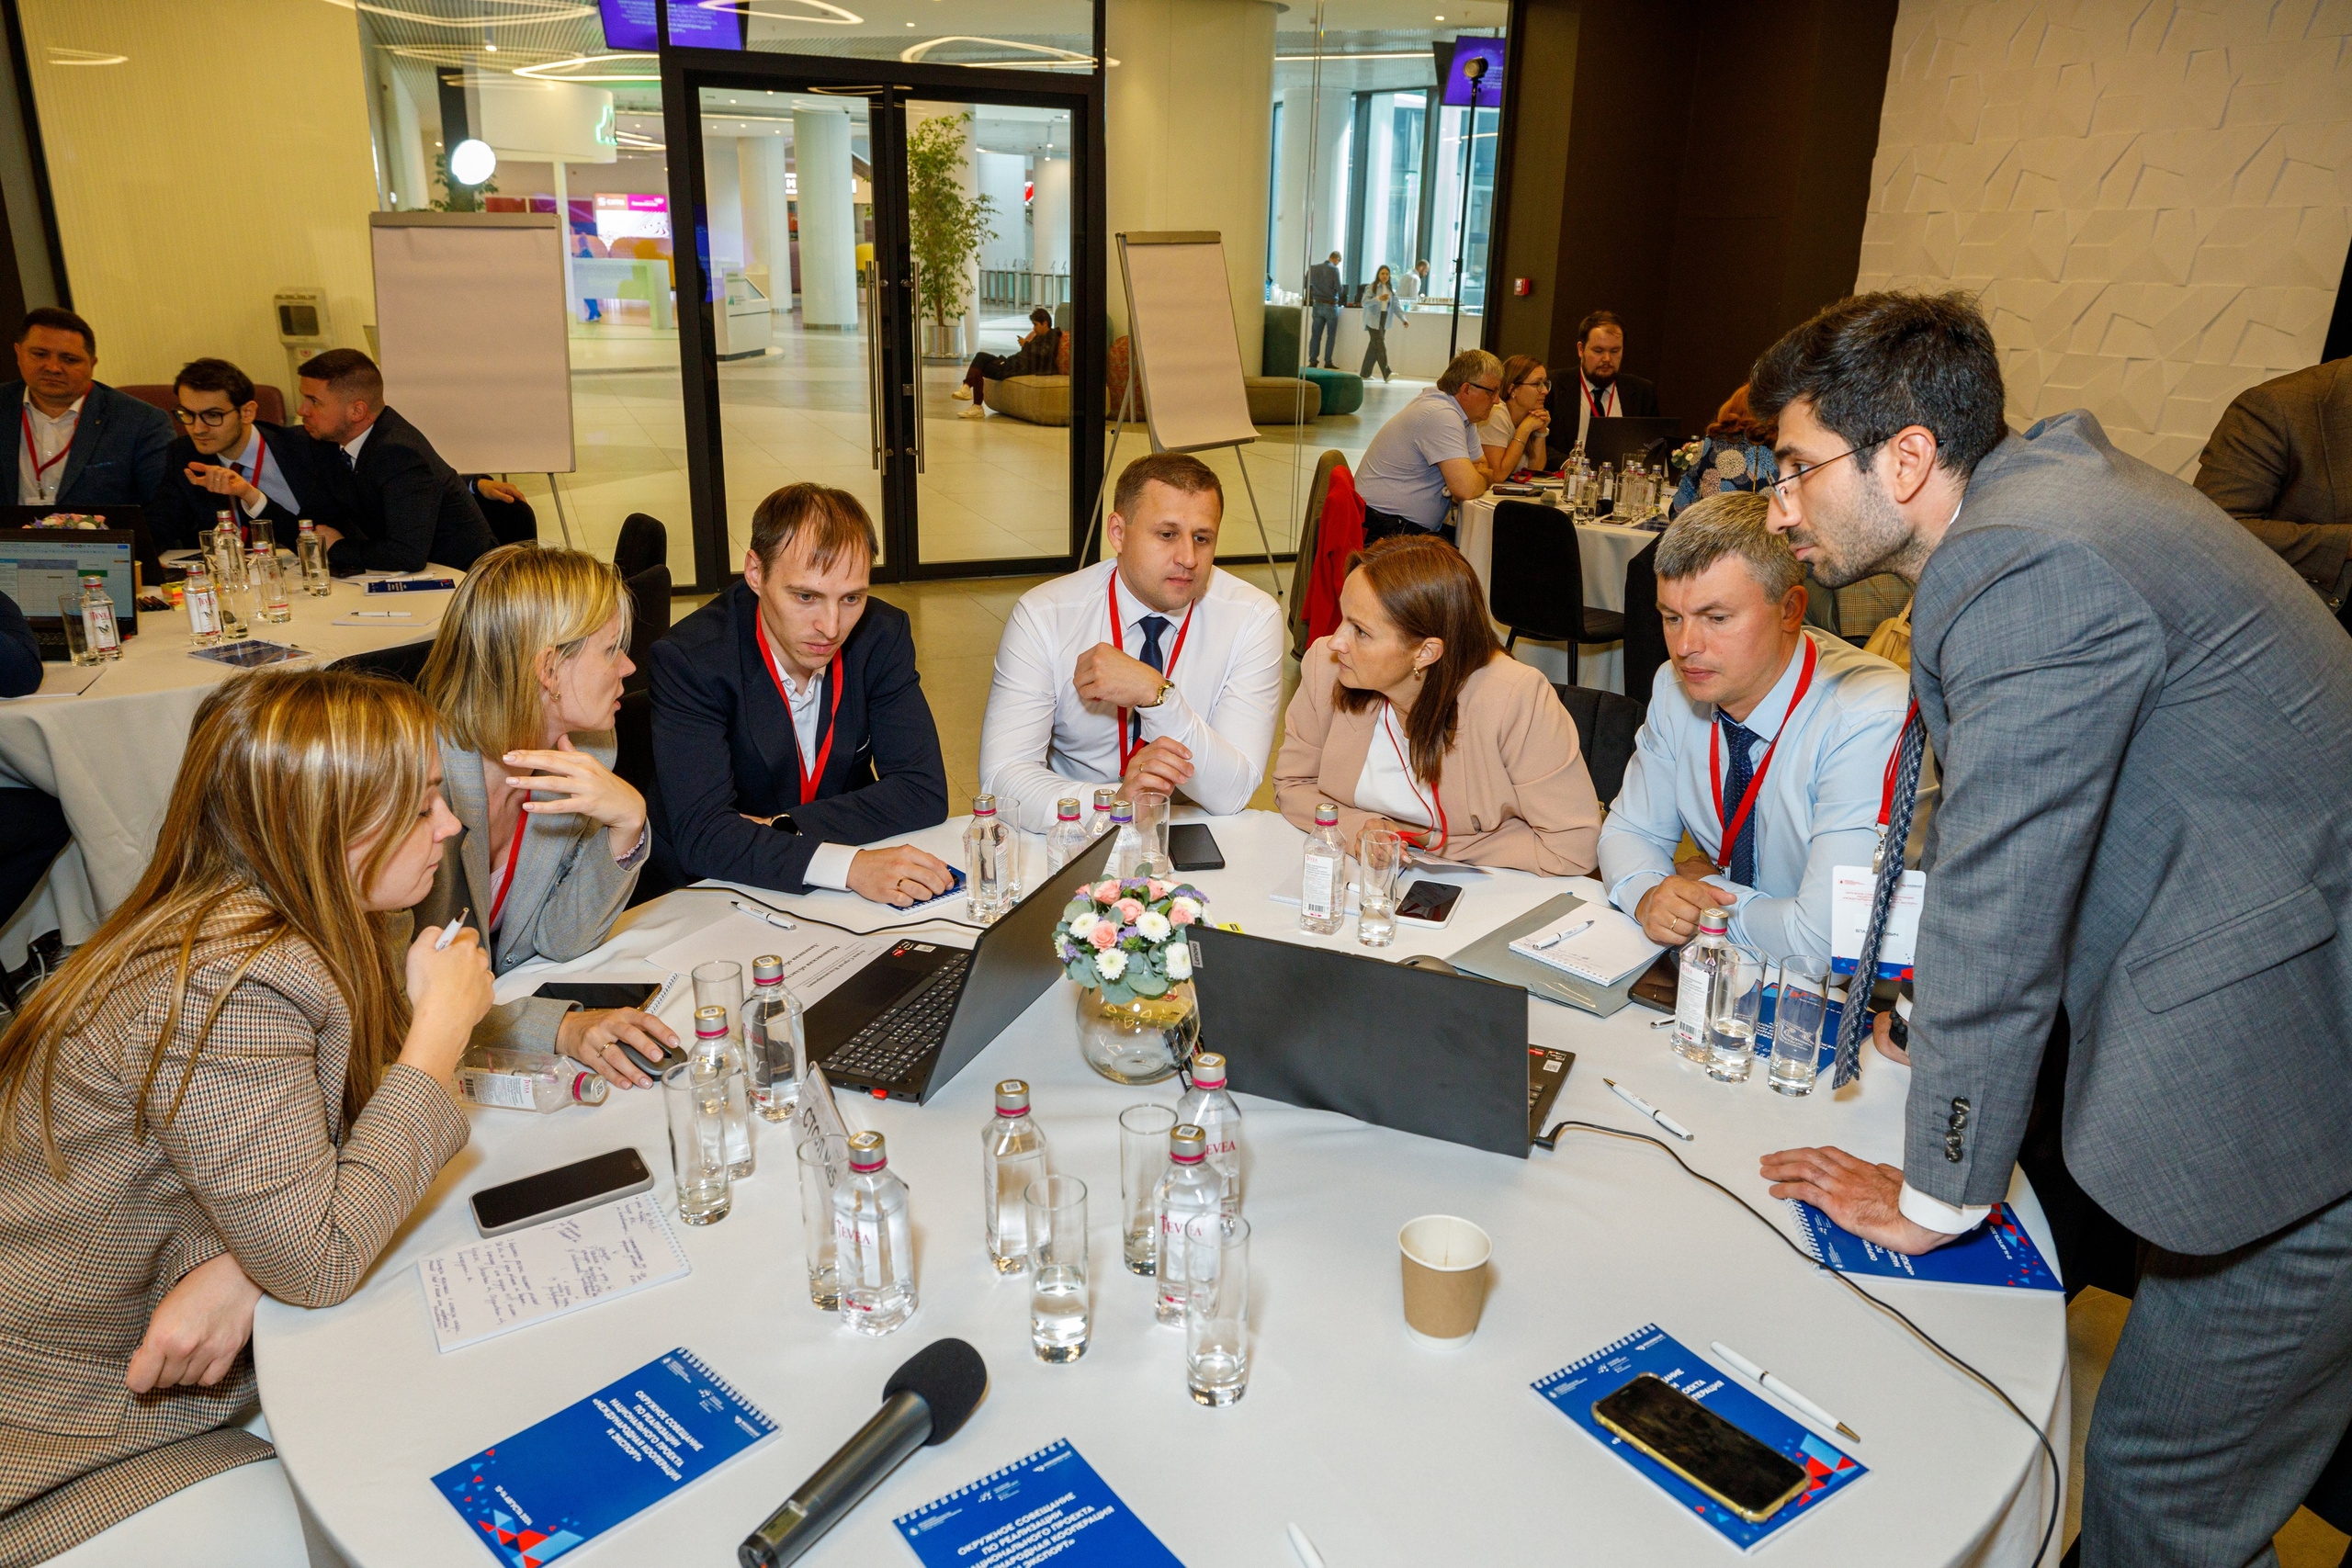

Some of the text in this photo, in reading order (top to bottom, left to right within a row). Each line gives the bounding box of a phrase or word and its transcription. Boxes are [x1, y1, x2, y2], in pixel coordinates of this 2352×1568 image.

[1205, 1140, 1236, 1156] EVEA
[1681, 1380, 1706, 1393] ОЕКТА
[1690, 1380, 1724, 1401] ПЕРАЦИЯ
[593, 1399, 682, 1481] «МЕЖДУНАРОДНАЯ КООПЕРАЦИЯ
[610, 1399, 660, 1443] НАЦИОНАЛЬНОГО
[656, 1441, 684, 1467] ПРОЕКТА
[634, 1404, 681, 1447] ПО РЕАЛИЗАЦИИ
[636, 1391, 669, 1419] ОКРУЖНОЕ
[665, 1418, 703, 1451] СОВЕЩАНИЕ
[612, 1433, 641, 1461] ЭКСПОРТ»
[957, 1523, 1015, 1555] ОКРУЖНОЕ
[1014, 1492, 1076, 1527] СОВЕЩАНИЕ
[969, 1506, 1095, 1568] АЦИОНАЛЬНОГО ПРОЕКТА
[981, 1509, 1063, 1555] ПО РЕАЛИЗАЦИИ
[1050, 1506, 1114, 1543] КООПЕРАЦИЯ
